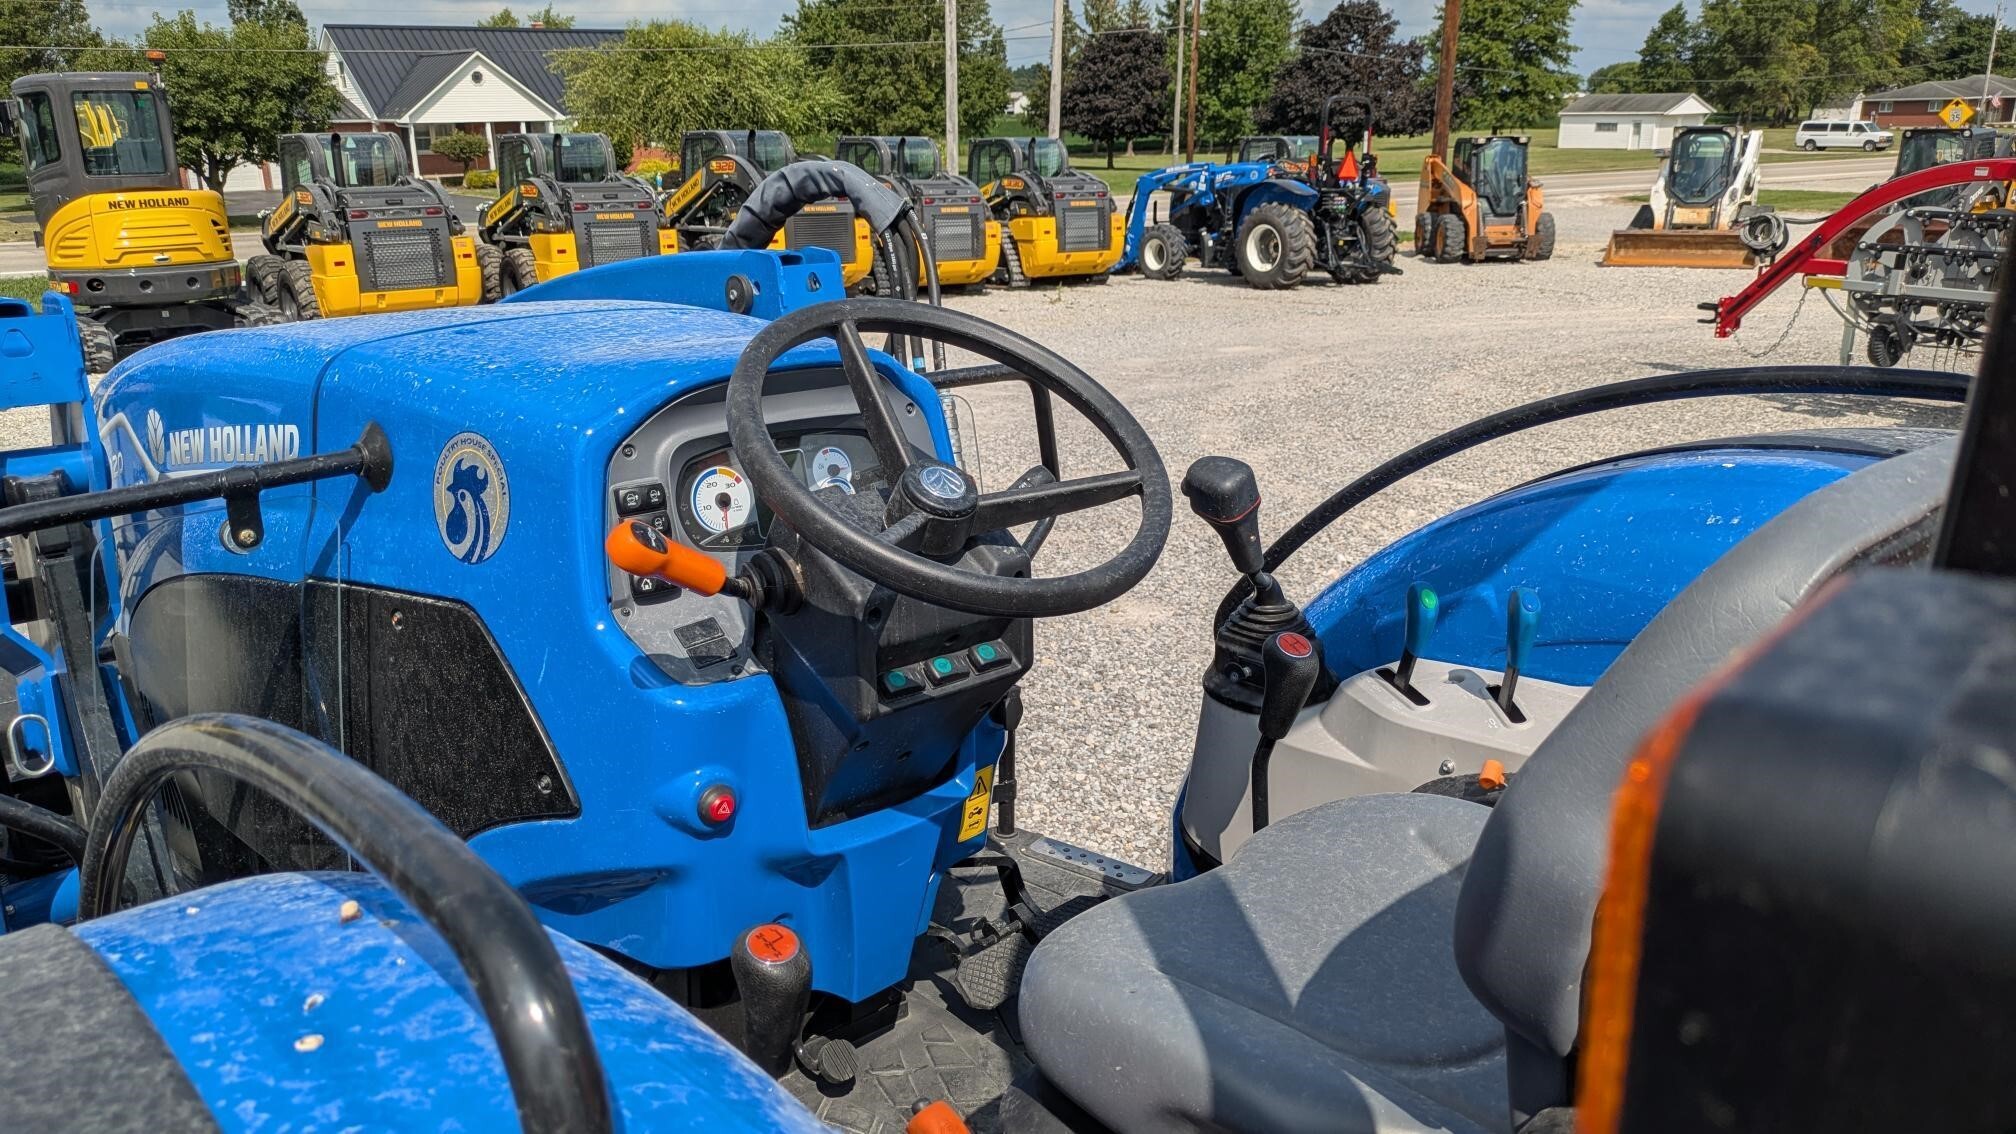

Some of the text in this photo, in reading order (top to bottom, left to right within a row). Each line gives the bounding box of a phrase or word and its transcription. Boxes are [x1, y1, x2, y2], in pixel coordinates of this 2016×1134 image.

[1951, 113, 1960, 122] 35
[108, 197, 189, 210] NEW HOLLAND
[596, 212, 635, 220] NEW HOLLAND
[377, 219, 423, 228] NEW HOLLAND
[169, 424, 300, 465] NEW HOLLAND
[436, 437, 507, 497] POULTRY HOUSE SPECIAL
